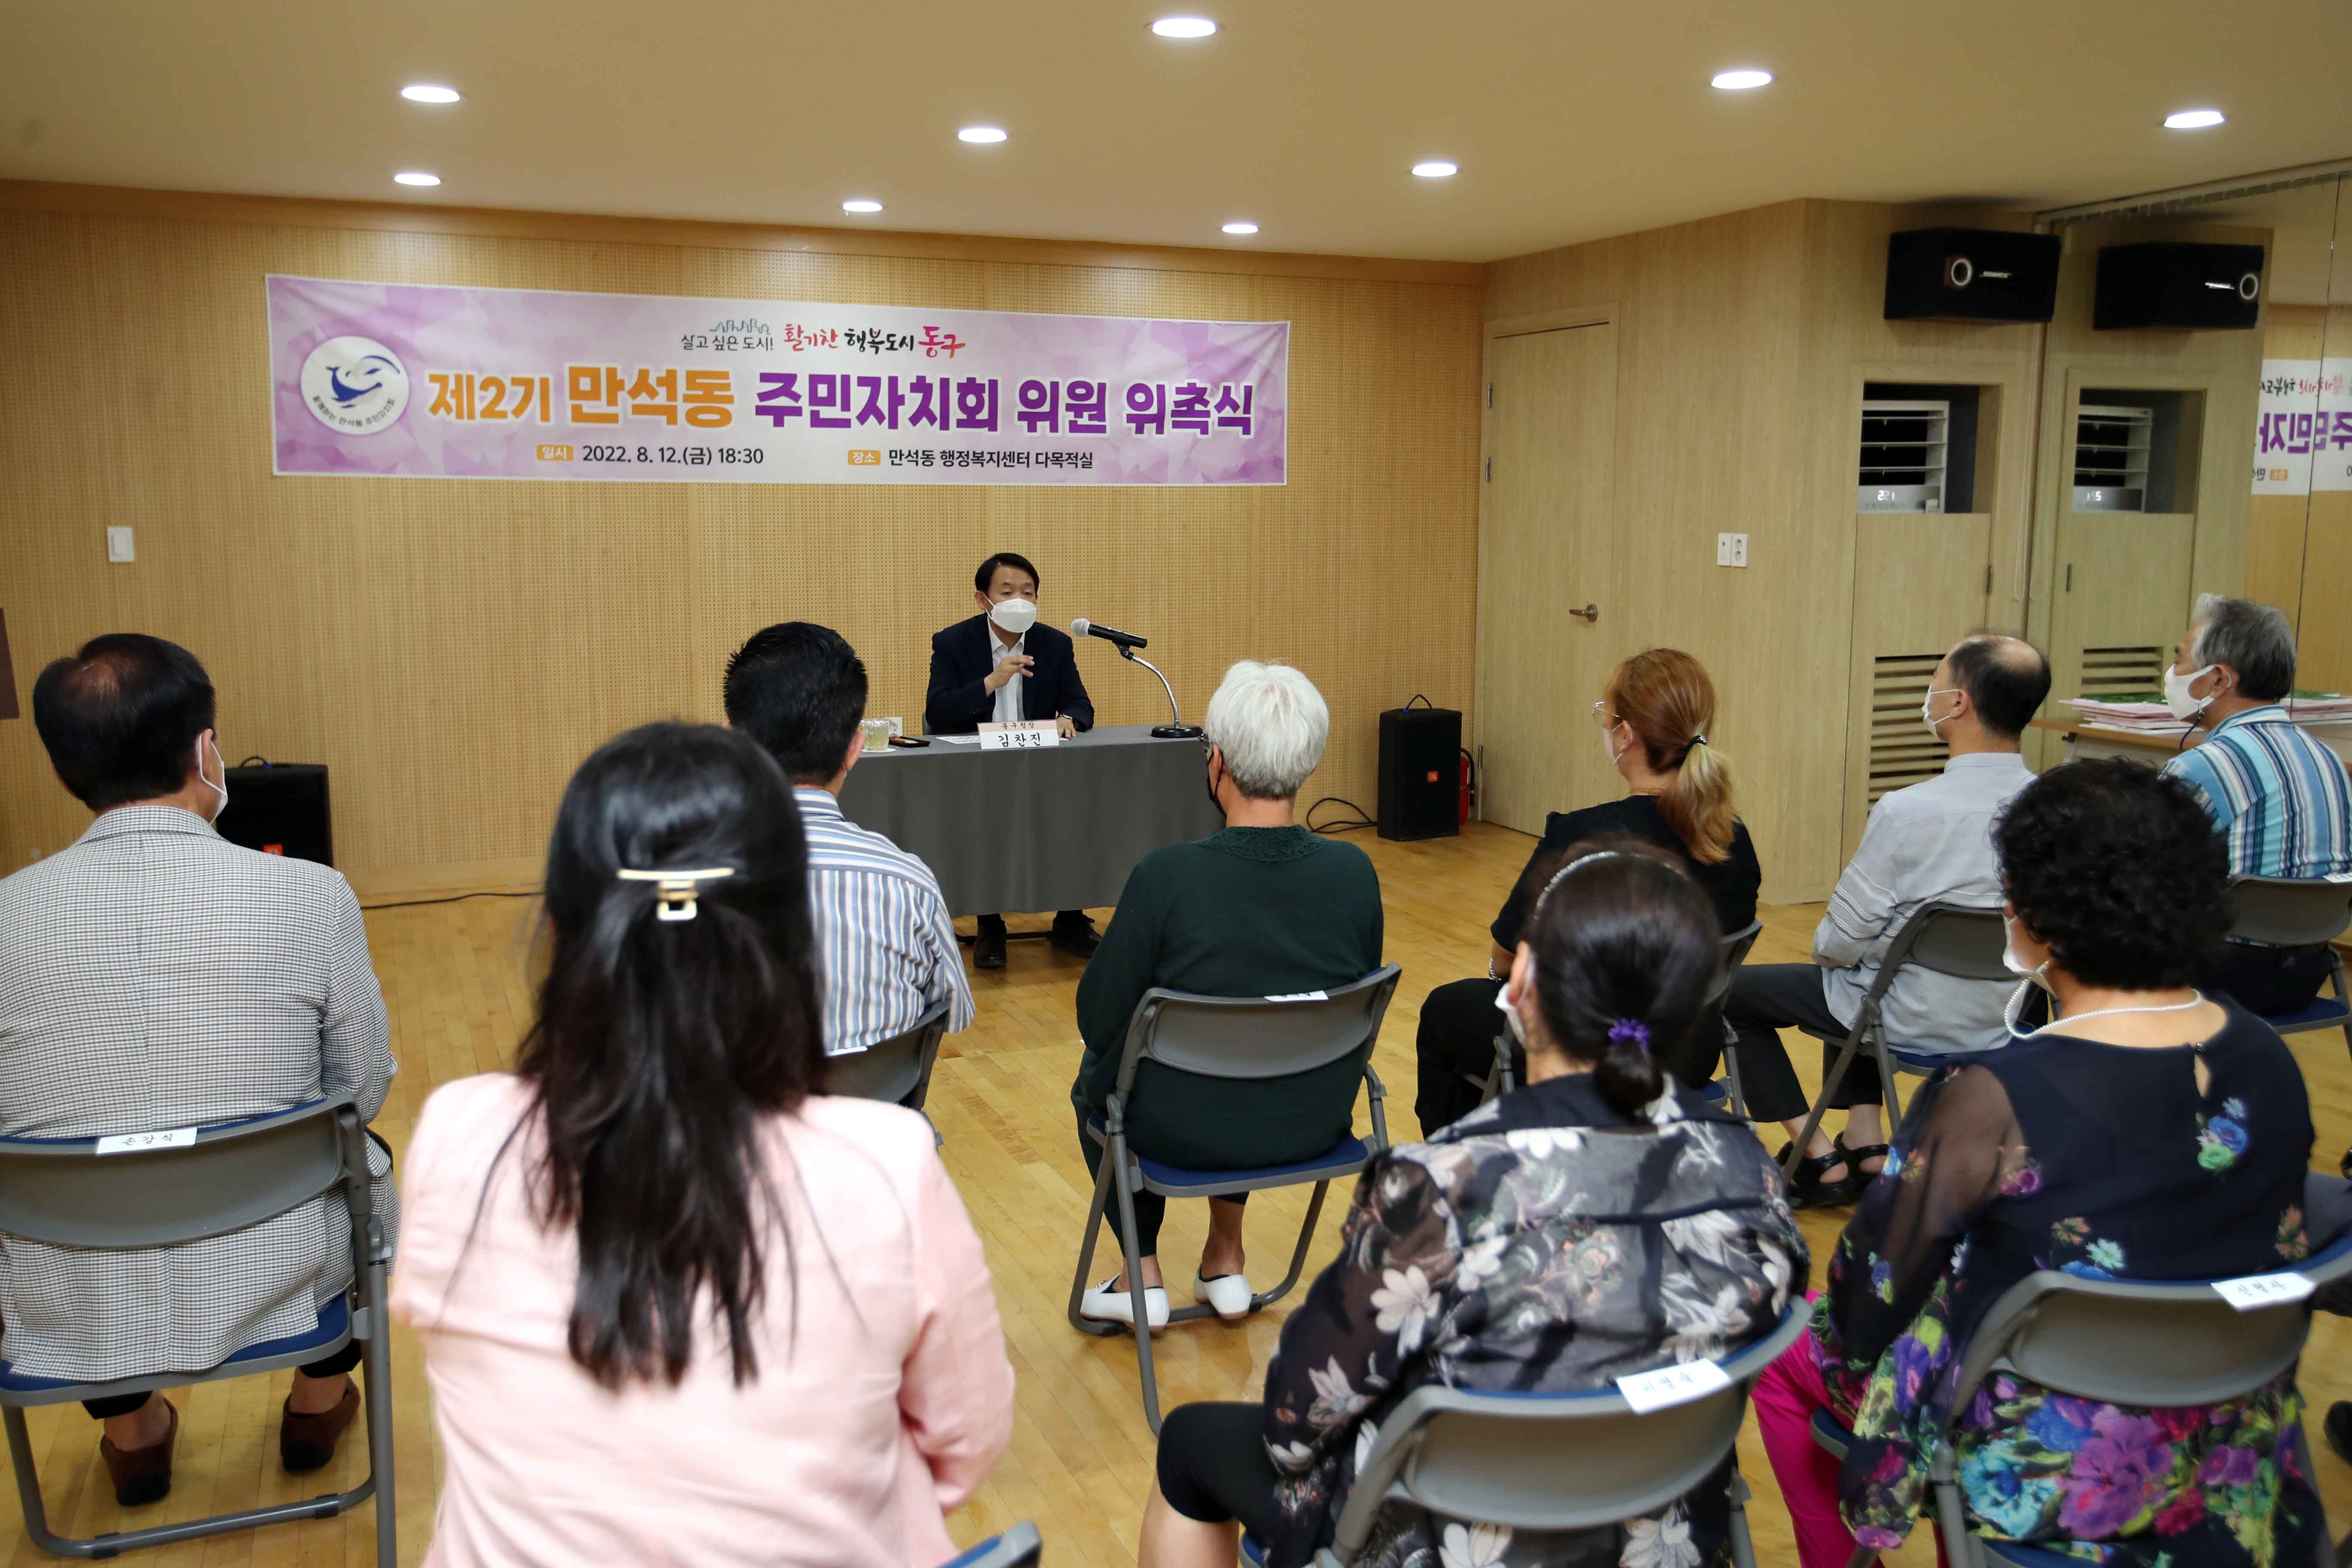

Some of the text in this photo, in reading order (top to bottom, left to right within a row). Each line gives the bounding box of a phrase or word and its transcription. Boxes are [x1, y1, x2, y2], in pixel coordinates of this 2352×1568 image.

[681, 335, 773, 351] 살고 싶은 도시!
[784, 324, 966, 358] 활기찬 행복도시 동구
[429, 366, 1253, 435] 제2기 만석동 주민자치회 위원 위촉식
[542, 445, 764, 466] 일시 2022. 8. 12.(금) 18:30
[852, 449, 1093, 469] 장소 만석동 행정복지센터 다목적실
[998, 732, 1041, 748] 김찬진
